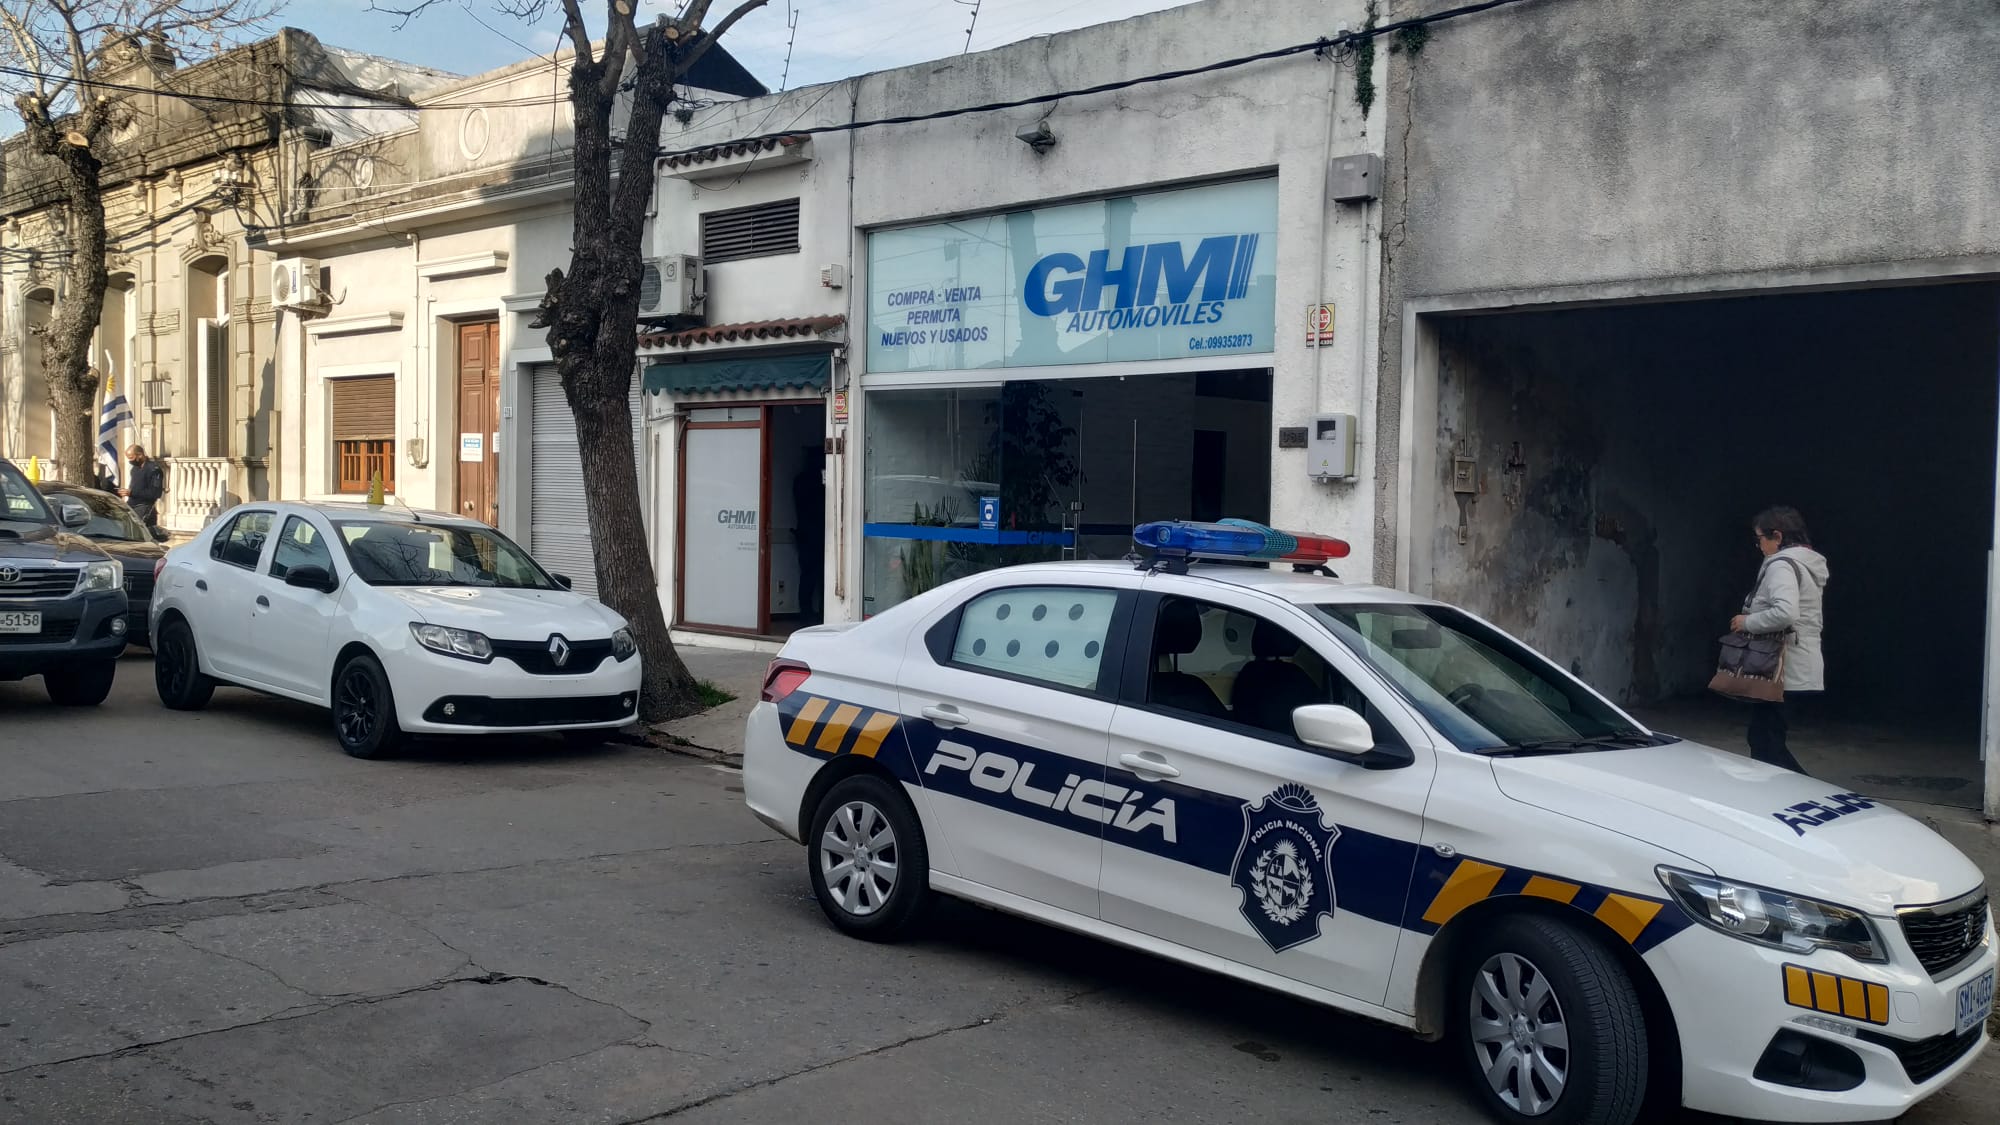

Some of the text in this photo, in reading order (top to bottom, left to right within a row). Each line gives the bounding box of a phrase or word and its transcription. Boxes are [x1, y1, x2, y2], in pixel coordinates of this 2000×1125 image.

[887, 290, 934, 306] COMPRA
[945, 286, 981, 302] VENTA
[907, 308, 960, 325] PERMUTA
[1066, 301, 1224, 333] AUTOMOVILES
[881, 326, 988, 346] NUEVOS Y USADOS
[5, 614, 39, 626] 5158
[1250, 819, 1323, 862] POLICIA NACIONAL
